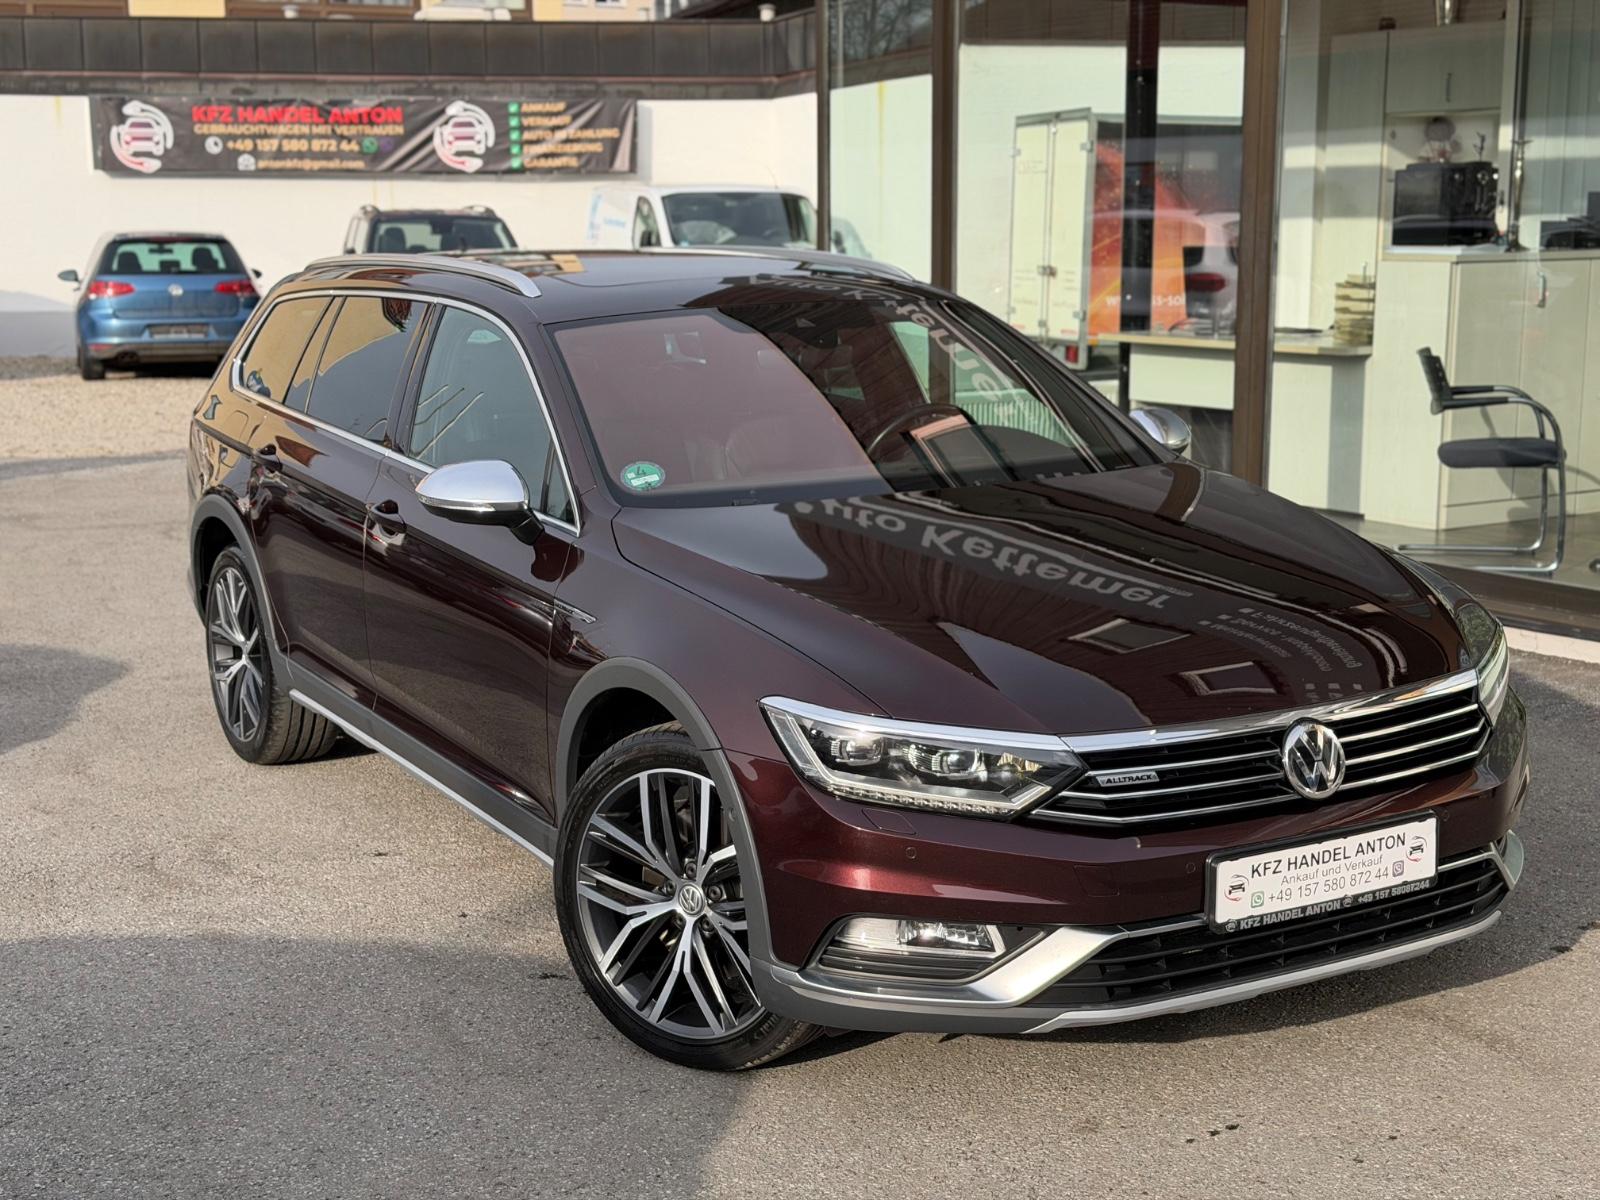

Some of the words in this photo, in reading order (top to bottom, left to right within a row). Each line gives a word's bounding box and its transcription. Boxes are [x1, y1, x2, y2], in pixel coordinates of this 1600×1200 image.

[191, 105, 232, 122] KFZ
[238, 105, 323, 122] HANDEL
[329, 107, 404, 123] ANTON
[193, 124, 310, 135] GEBRAUCHTWAGEN
[312, 124, 334, 136] MIT
[335, 125, 405, 136] VERTRAUEN
[227, 139, 254, 152] +49
[256, 139, 279, 152] 157
[281, 139, 308, 152] 580
[311, 139, 338, 152] 872
[1106, 773, 1152, 785] ALLTRACK
[1251, 858, 1283, 879] KFZ
[1287, 846, 1351, 871] HANDEL
[1355, 832, 1406, 856] ANTON
[1281, 868, 1319, 886] Ankauf
[1321, 864, 1342, 878] und
[1345, 854, 1384, 873] Verkauf
[1268, 887, 1292, 903] +49
[1298, 881, 1319, 898] 157
[1324, 875, 1346, 892] 580
[1349, 869, 1372, 886] 872
[1374, 866, 1389, 881] 44
[1240, 917, 1262, 930] KFZ
[1263, 908, 1304, 925] HANDEL
[1306, 900, 1341, 916] ANTON
[1357, 893, 1373, 904] +49
[1374, 889, 1390, 900] 157
[1391, 880, 1431, 897] 58087244
